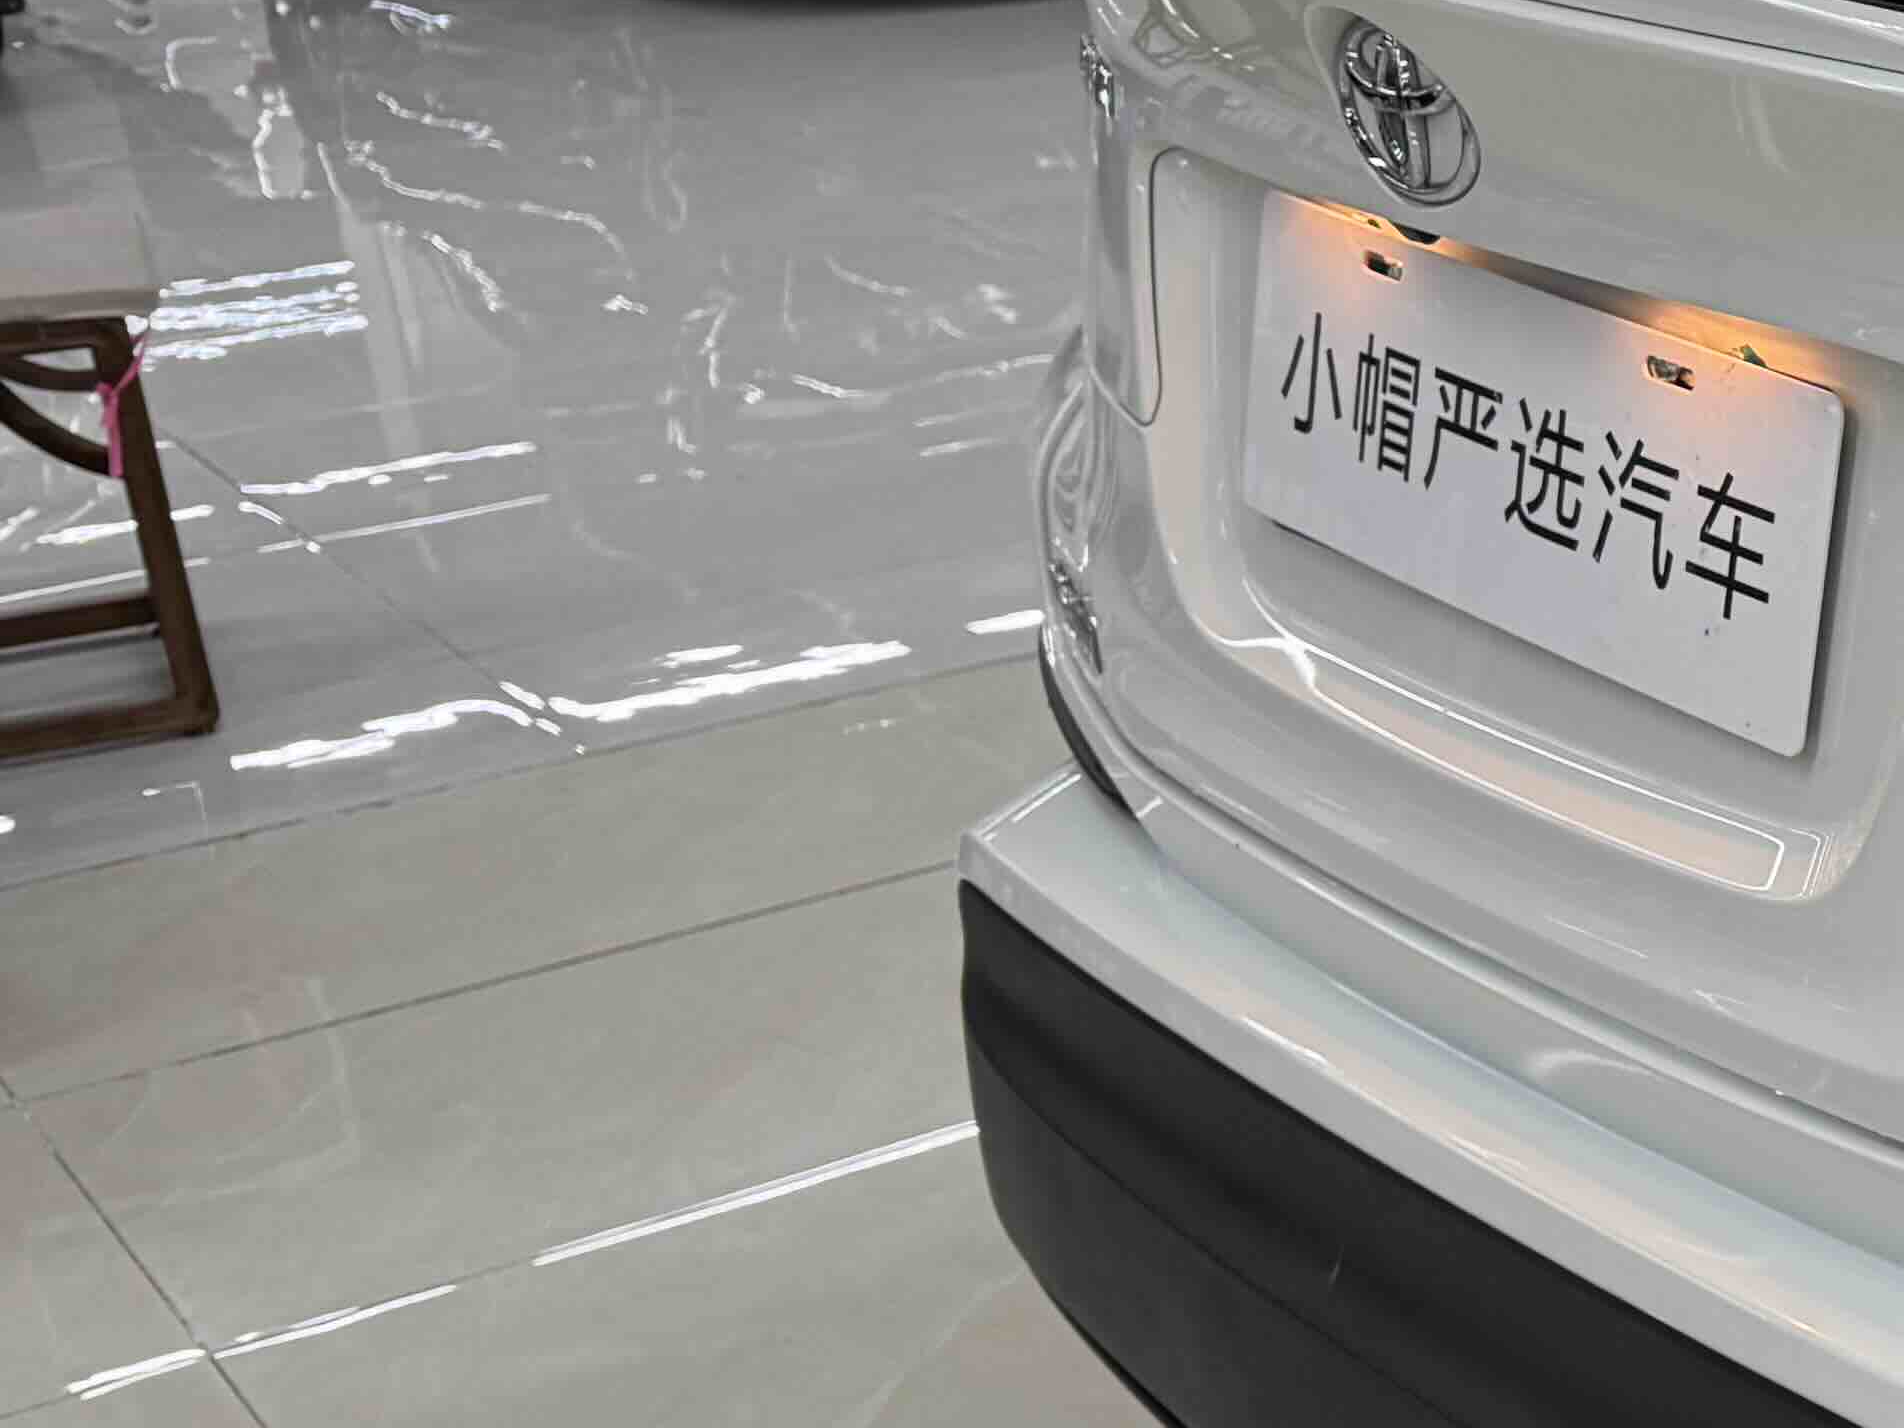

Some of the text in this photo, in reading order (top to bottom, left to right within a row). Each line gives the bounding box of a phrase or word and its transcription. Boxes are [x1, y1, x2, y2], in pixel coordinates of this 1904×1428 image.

[1282, 312, 1775, 619] 小帽严选汽车
